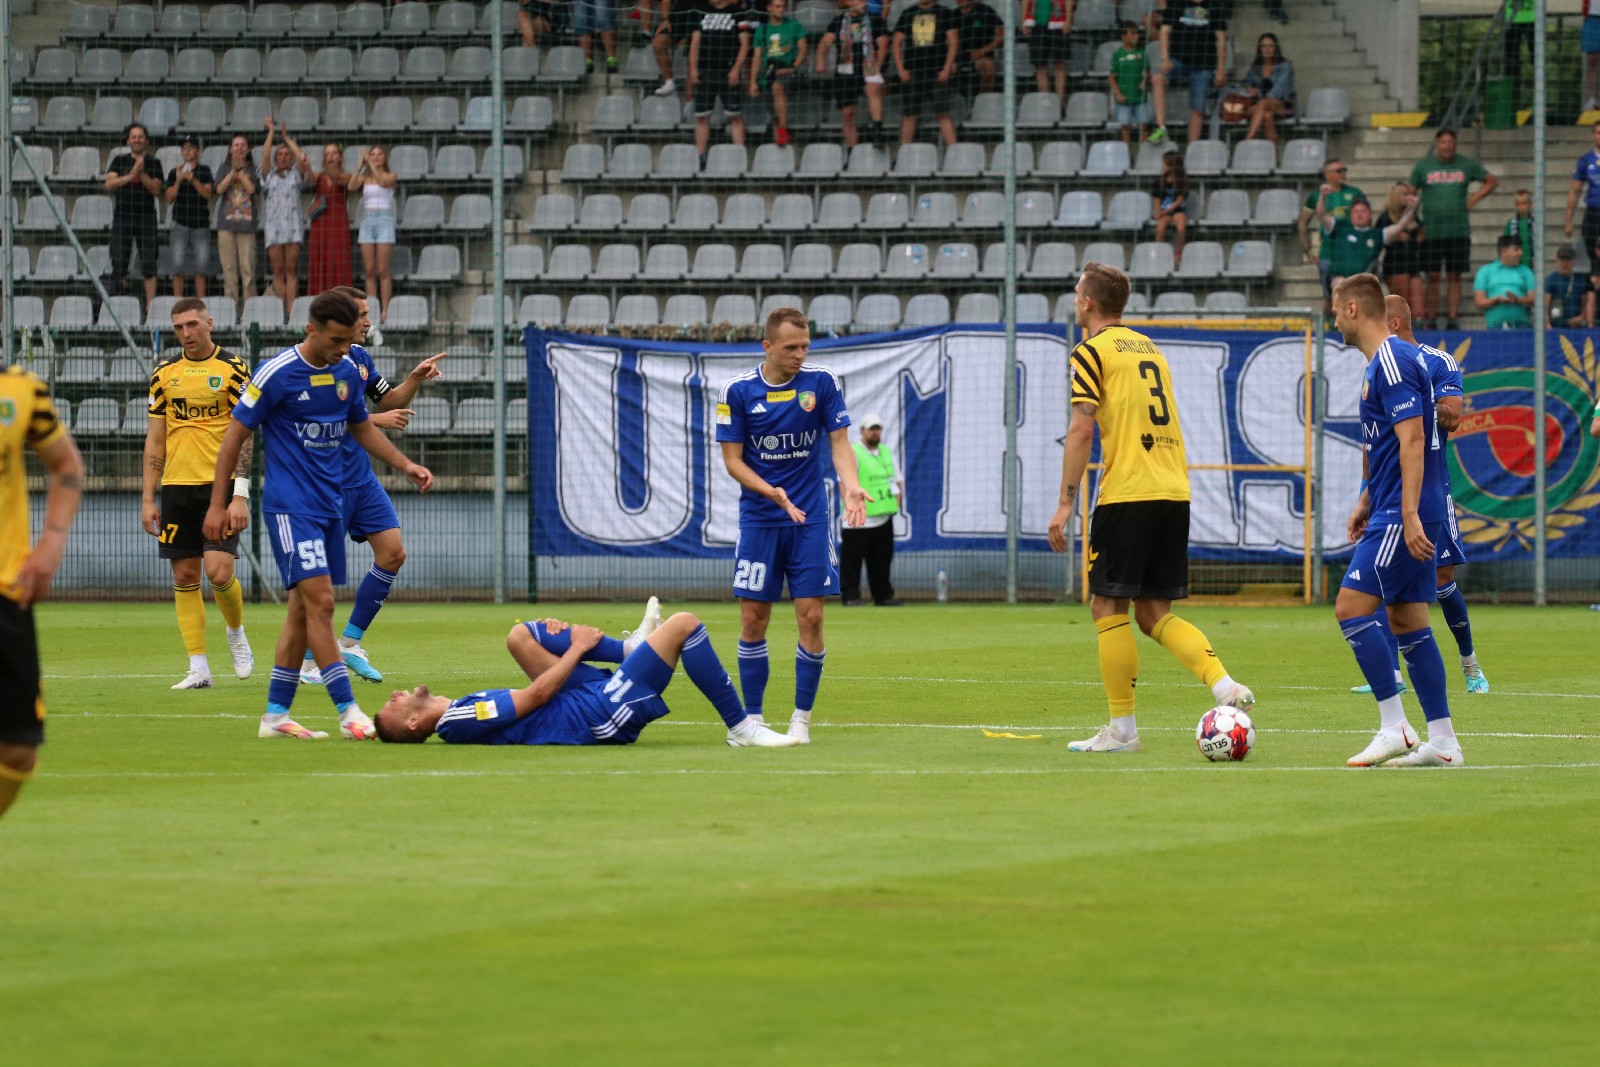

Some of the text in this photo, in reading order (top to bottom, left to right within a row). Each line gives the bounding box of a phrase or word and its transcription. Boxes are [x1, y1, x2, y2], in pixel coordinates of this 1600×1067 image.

[1139, 361, 1170, 425] 3
[172, 398, 219, 420] Nord
[294, 420, 347, 439] VOTUM
[751, 429, 817, 450] VOTUM
[760, 451, 792, 460] Finance
[297, 539, 328, 571] 59
[732, 558, 767, 592] 20
